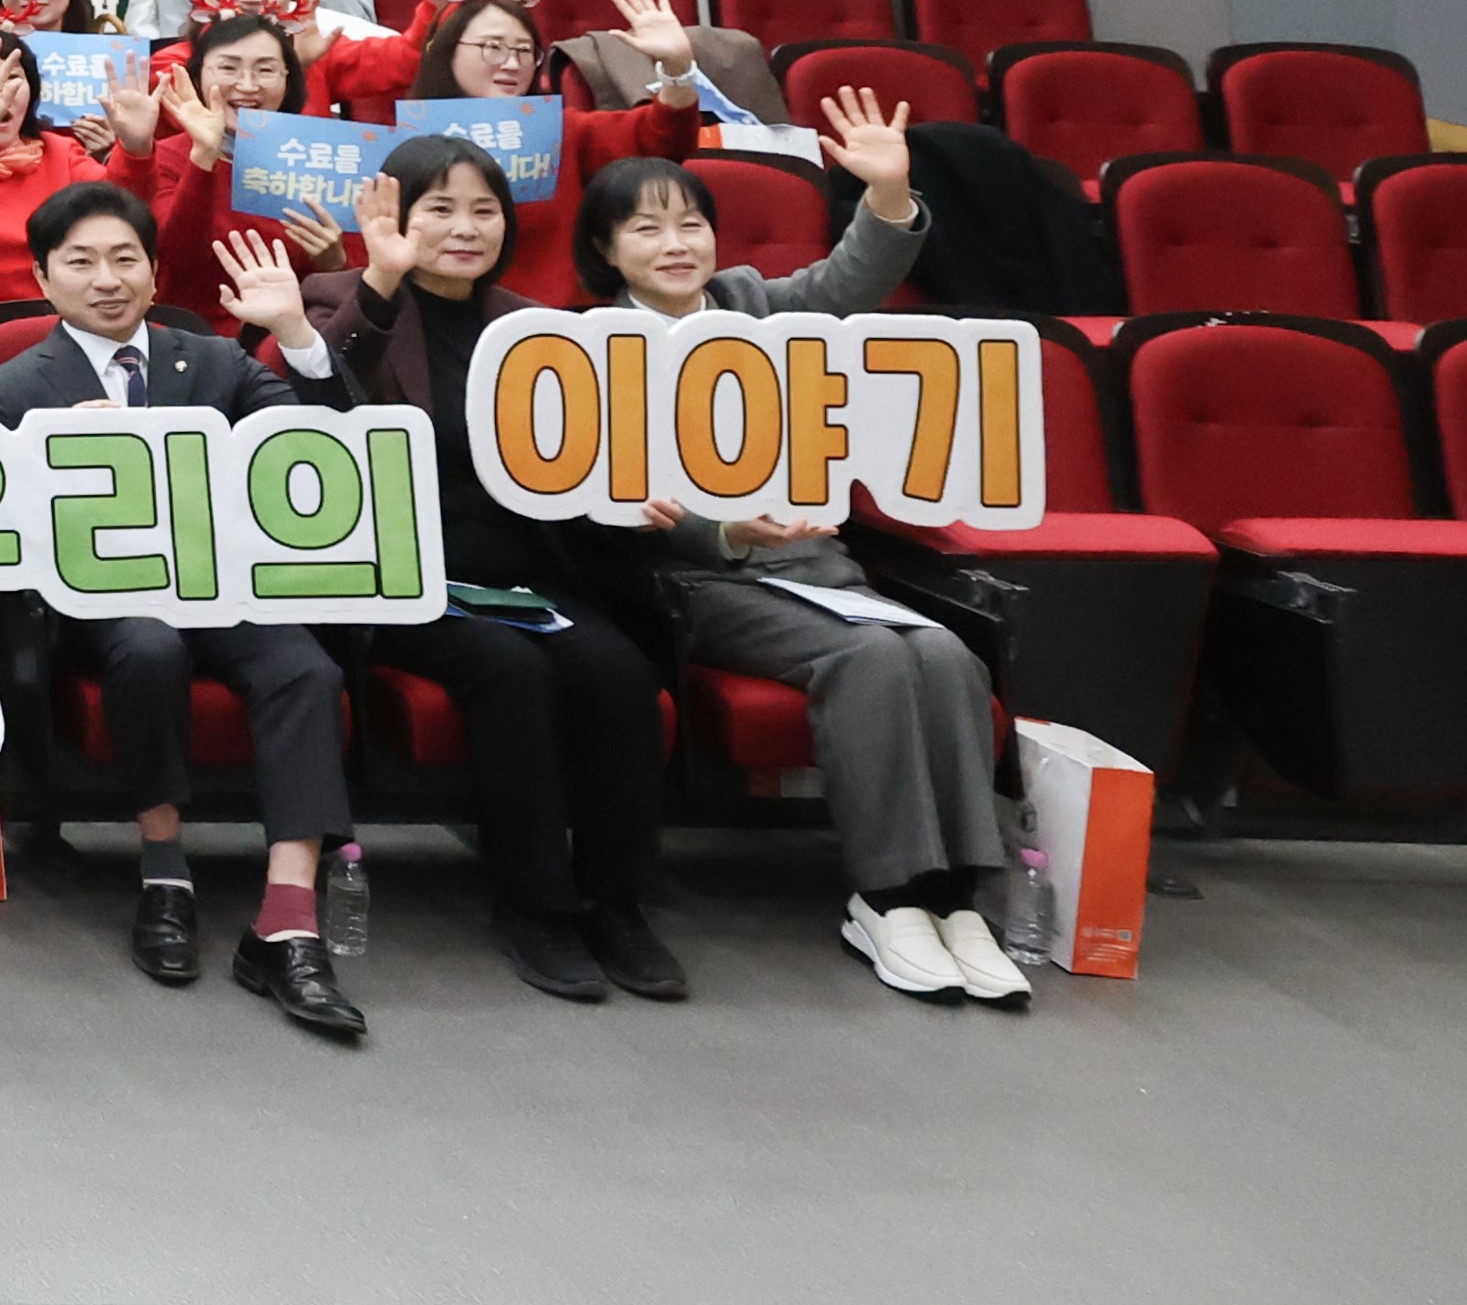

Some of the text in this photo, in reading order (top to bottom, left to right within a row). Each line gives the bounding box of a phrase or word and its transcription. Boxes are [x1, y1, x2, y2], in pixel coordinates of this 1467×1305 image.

[42, 51, 110, 78] 수료를
[277, 139, 361, 174] 수료를
[241, 167, 363, 206] 축하합니
[494, 333, 1022, 508] 이야기
